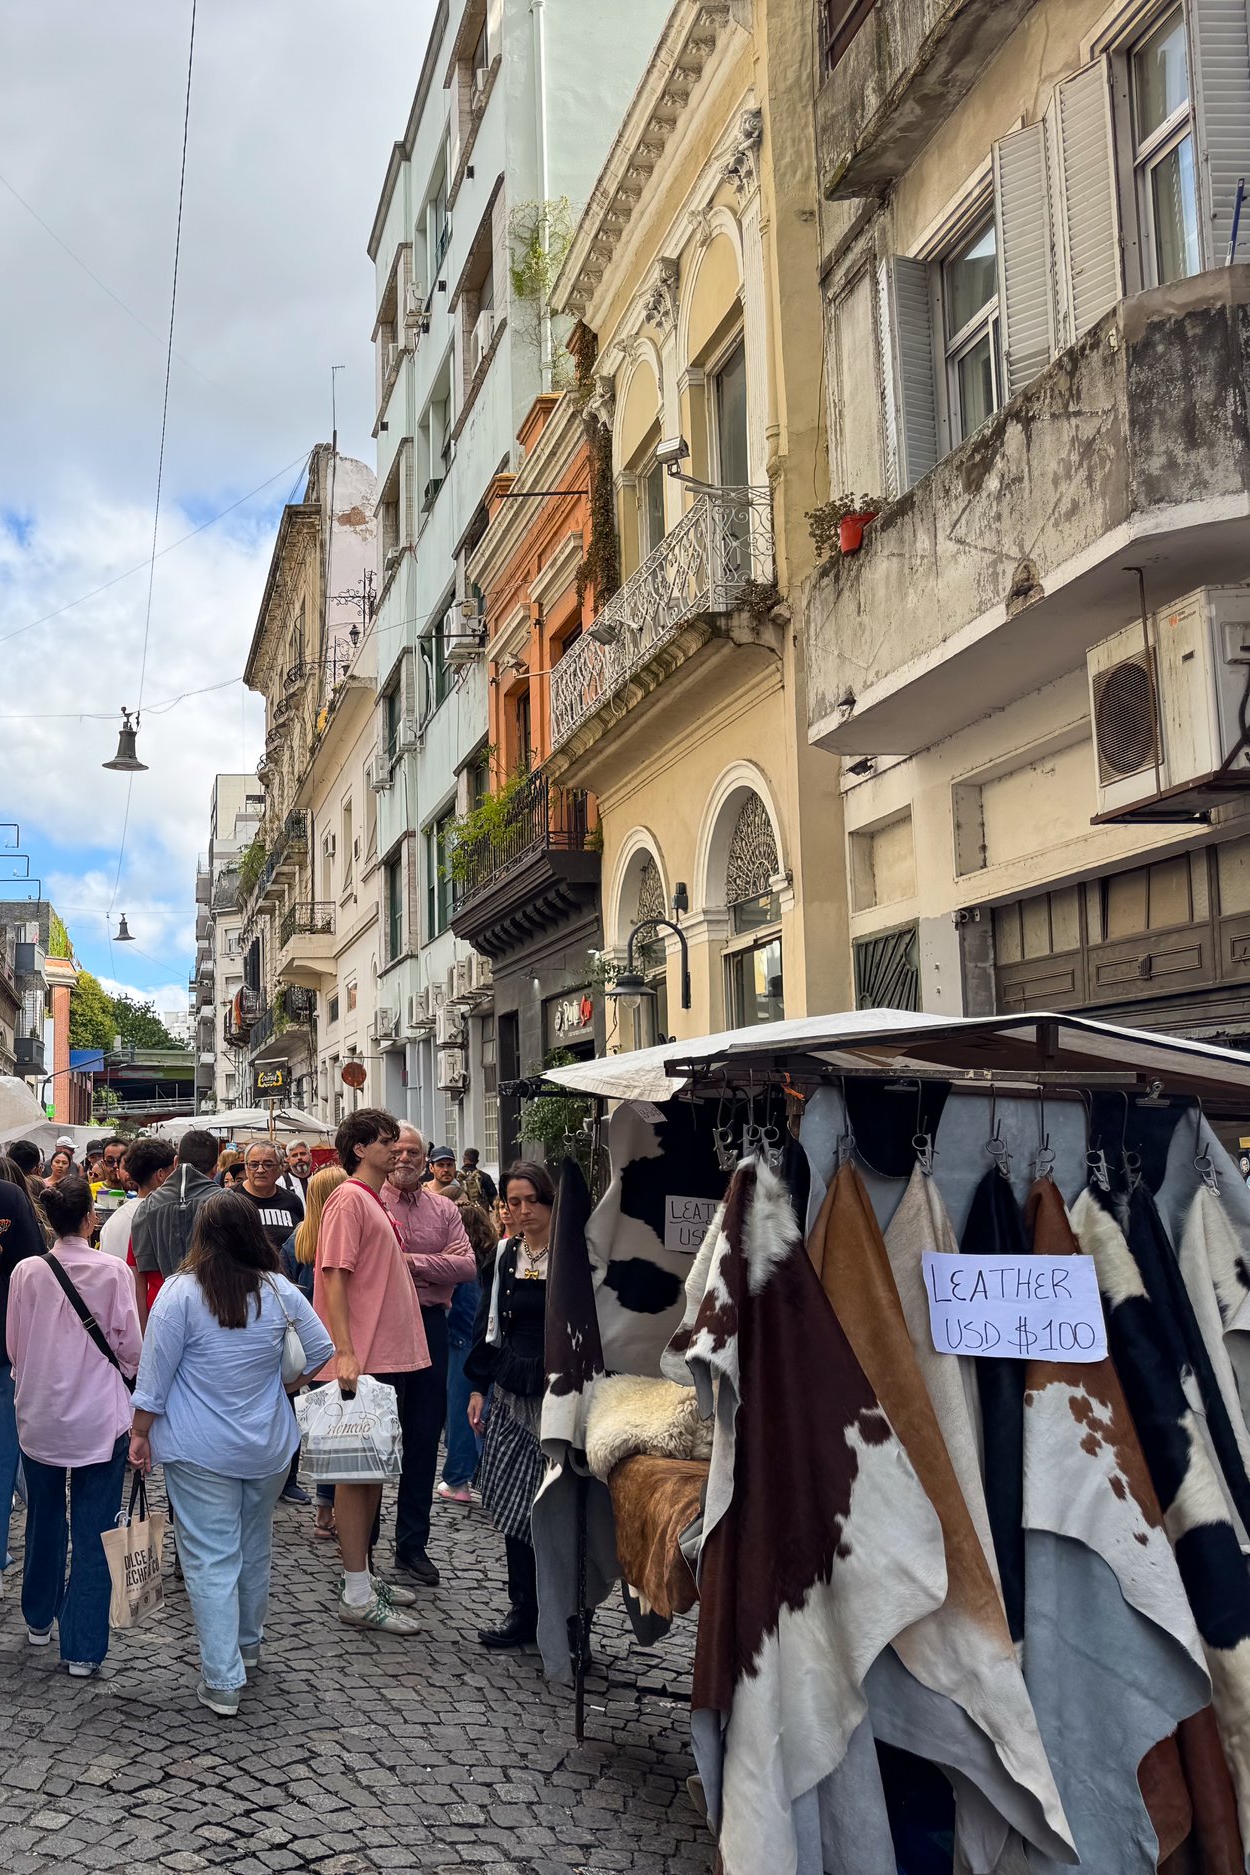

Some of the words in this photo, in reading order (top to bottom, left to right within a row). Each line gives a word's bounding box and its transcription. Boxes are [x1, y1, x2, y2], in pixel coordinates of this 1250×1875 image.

[671, 1200, 717, 1220] LEAT
[931, 1263, 1072, 1303] LEATHER
[945, 1318, 1001, 1352] USD
[1007, 1316, 1096, 1354] $100
